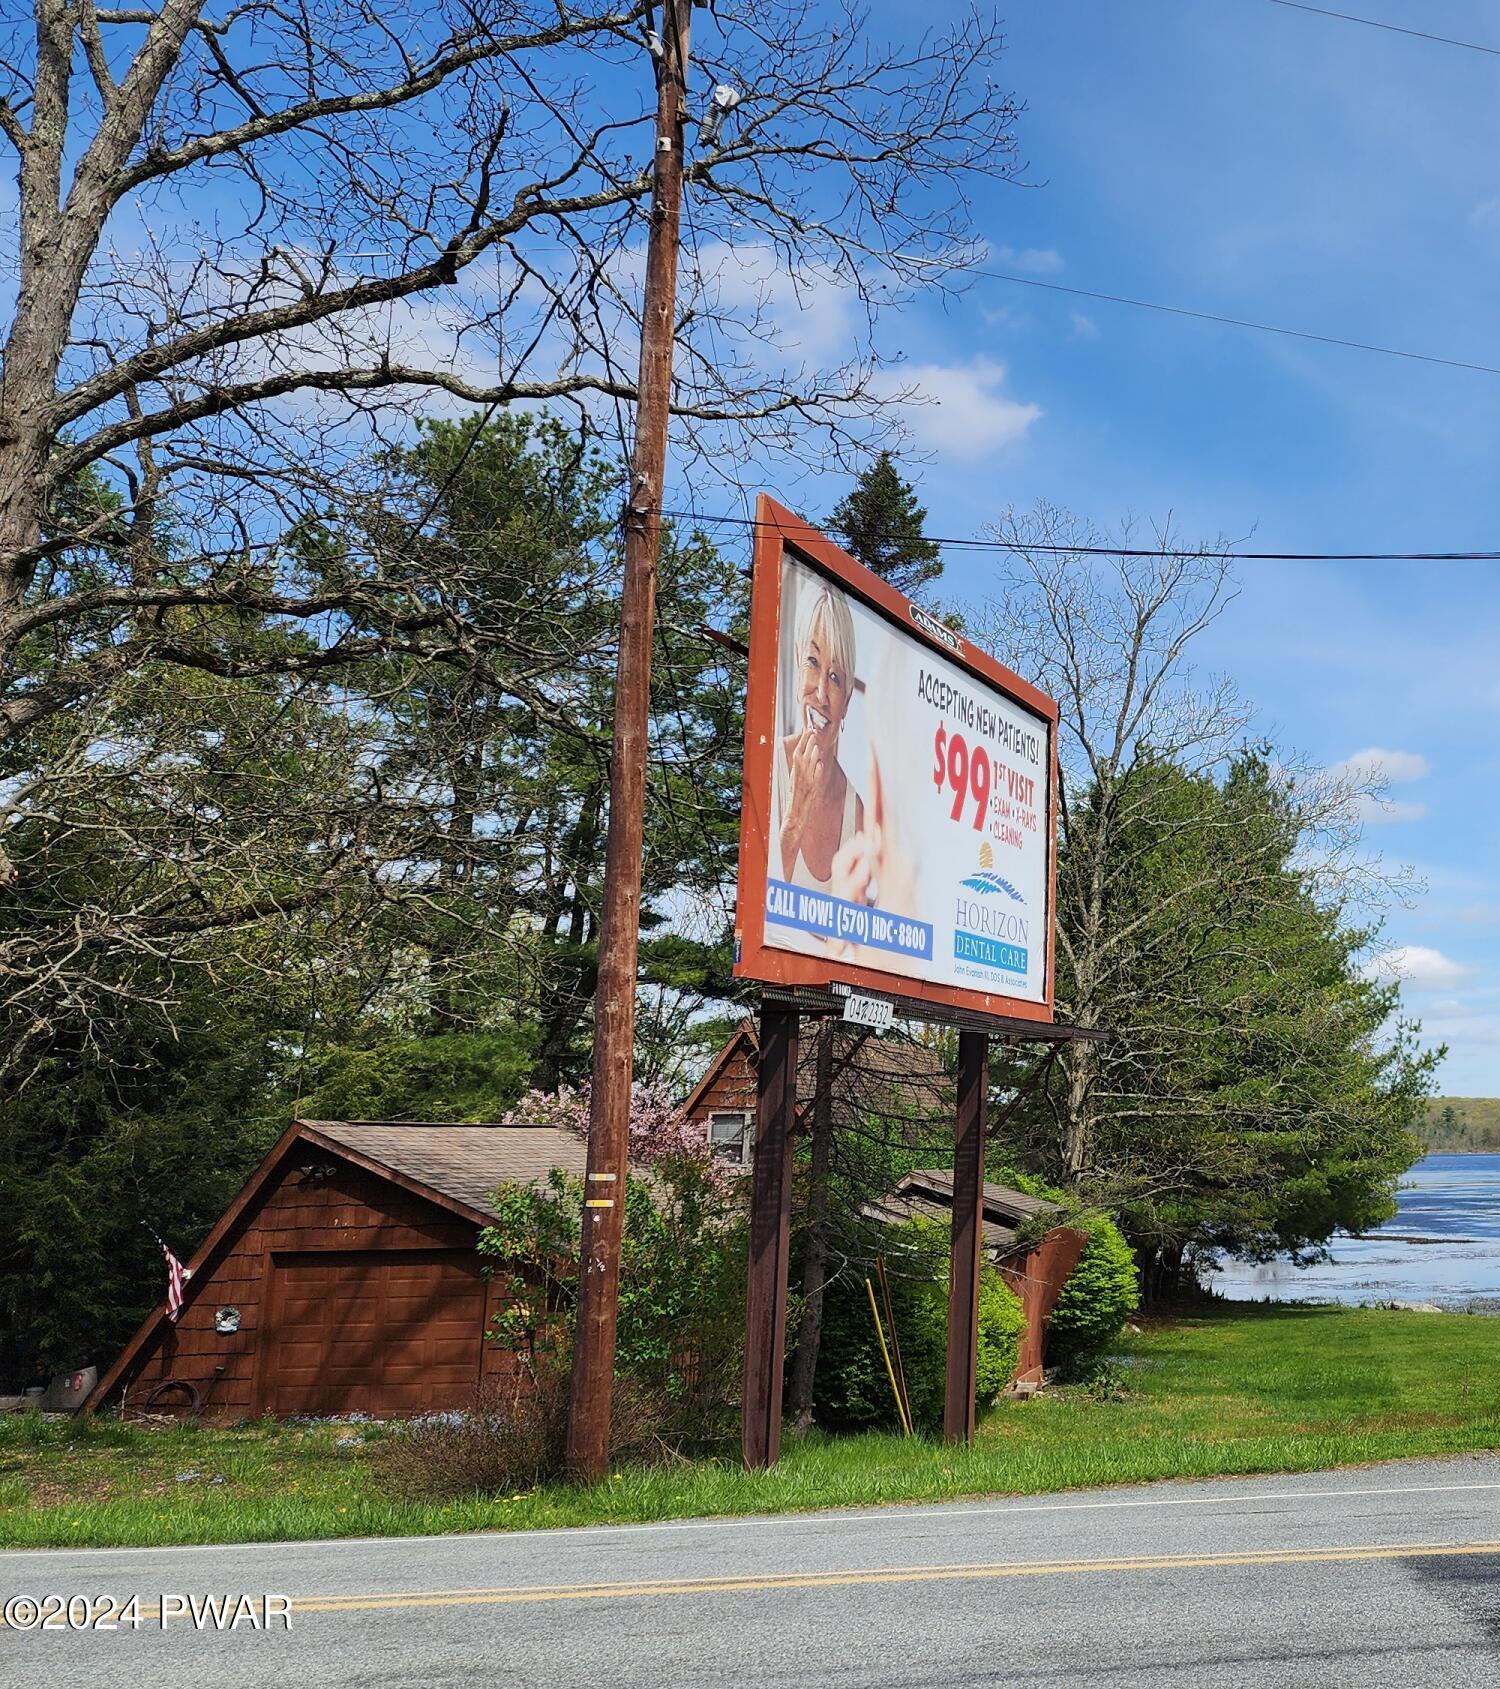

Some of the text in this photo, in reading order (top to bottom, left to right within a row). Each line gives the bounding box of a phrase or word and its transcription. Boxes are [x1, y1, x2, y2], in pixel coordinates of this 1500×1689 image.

[914, 612, 955, 646] ADAMS
[918, 669, 1040, 765] ACCEPTING NEW PATIENTS!
[933, 719, 991, 832] $99
[1008, 767, 1035, 808] VISIT
[994, 796, 1011, 820] EXAM
[993, 820, 1023, 849] CLEANING
[767, 886, 796, 919] CALL
[798, 894, 833, 928] NOW!
[837, 903, 869, 944] (570)
[956, 898, 1029, 944] HORIZON
[956, 935, 1026, 969] DENTAL CARE
